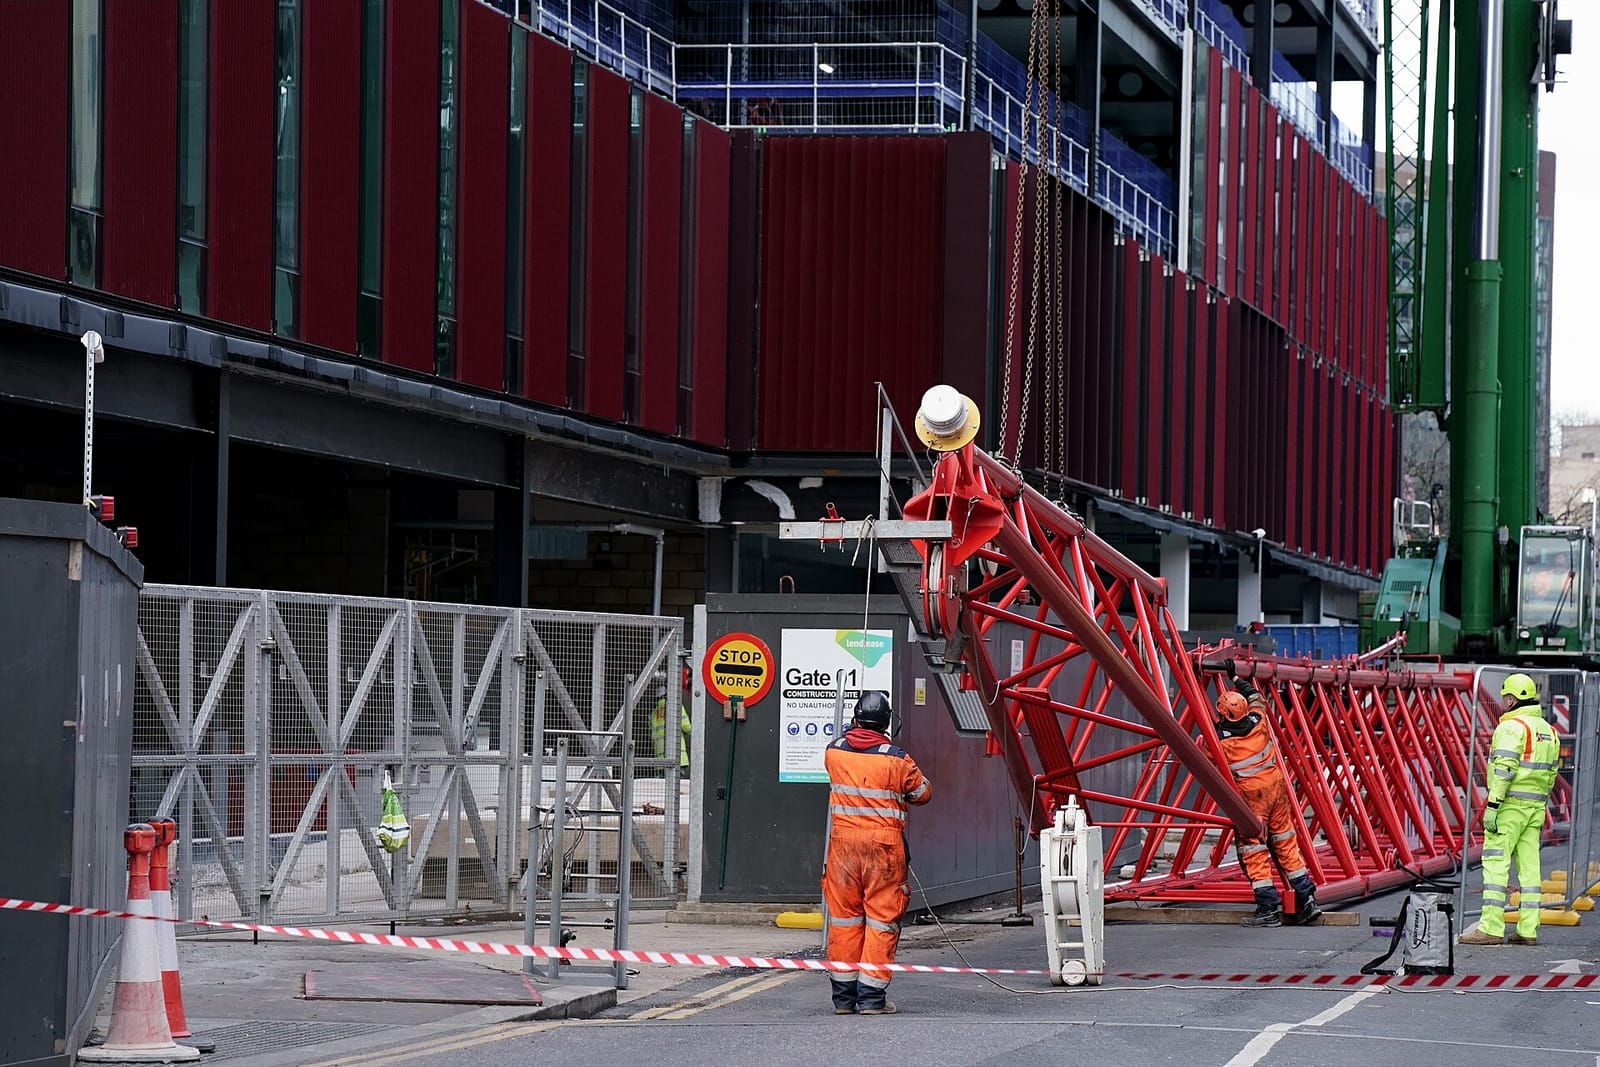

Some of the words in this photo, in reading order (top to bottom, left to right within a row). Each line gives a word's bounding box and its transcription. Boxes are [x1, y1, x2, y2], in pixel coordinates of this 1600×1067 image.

[846, 639, 885, 648] lendease
[718, 649, 762, 664] STOP
[715, 675, 760, 689] WORKS
[785, 667, 831, 687] Gate
[786, 690, 837, 698] CONSTRUCTIO
